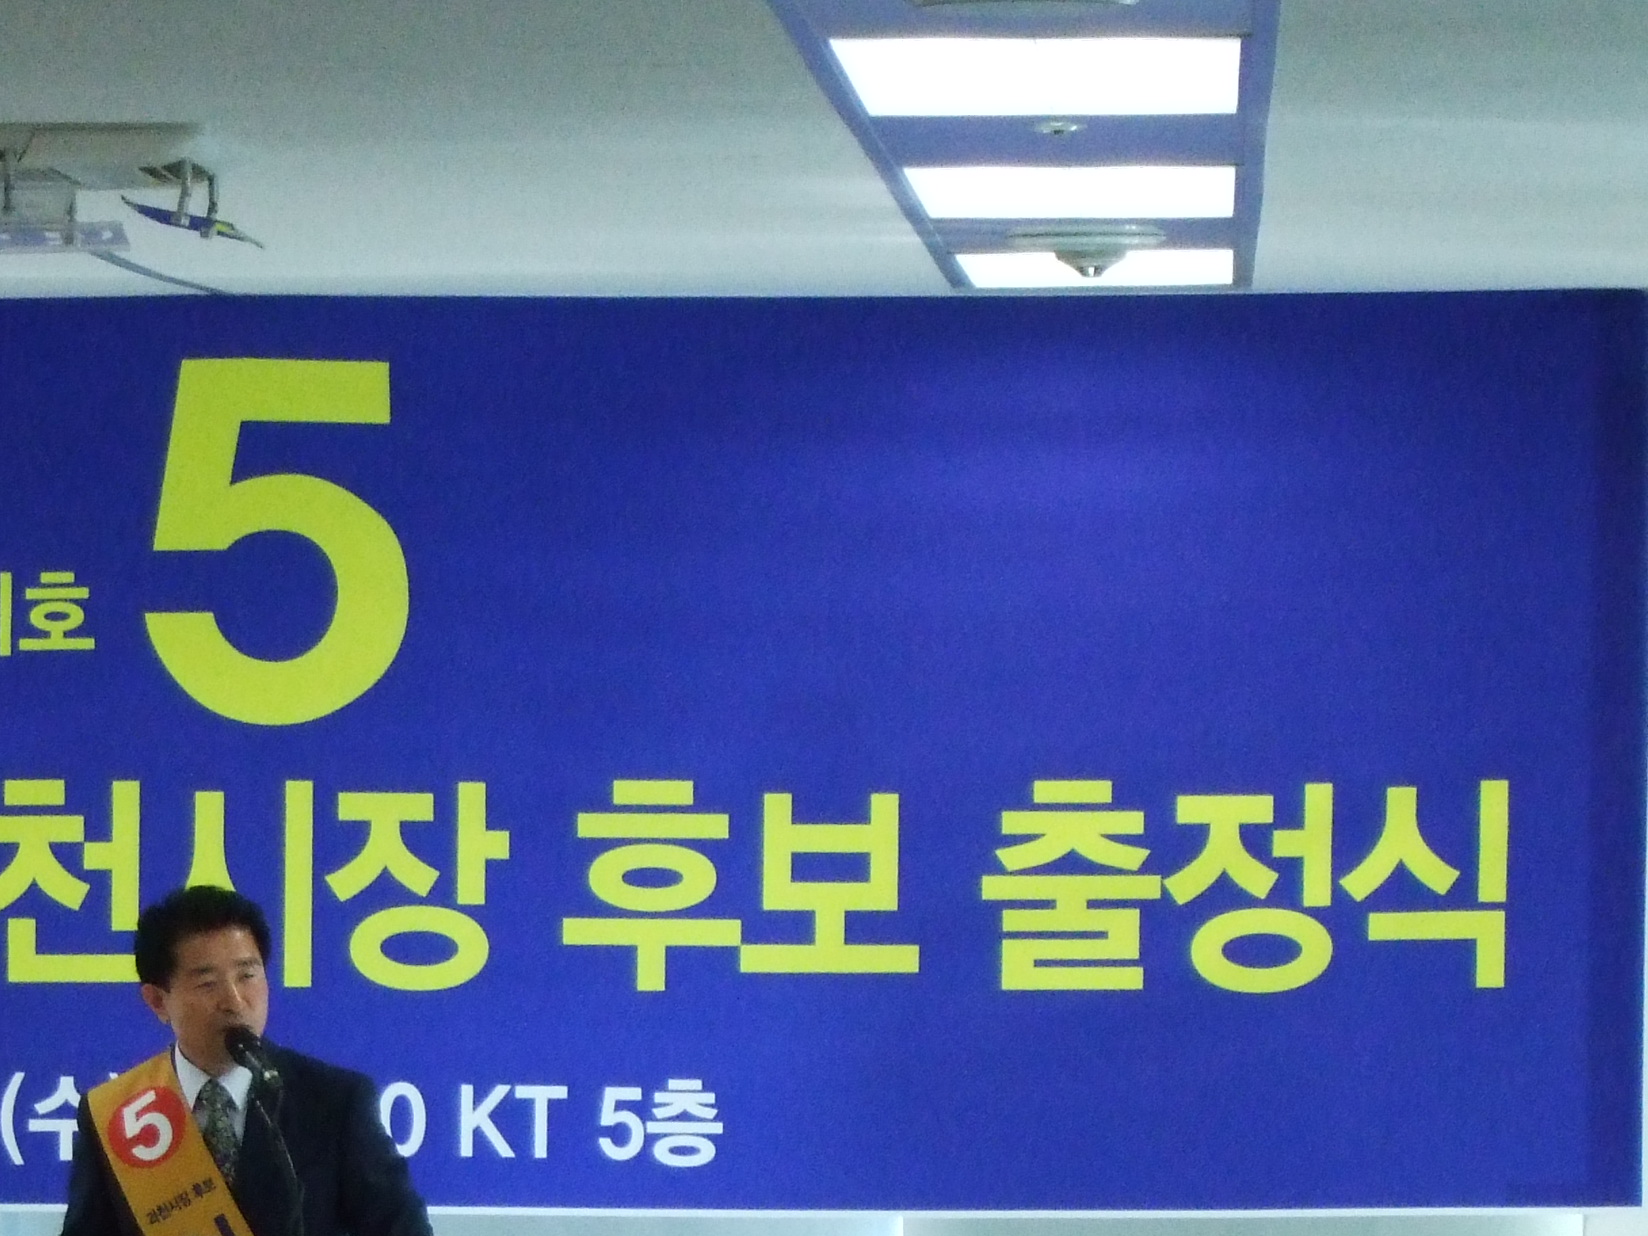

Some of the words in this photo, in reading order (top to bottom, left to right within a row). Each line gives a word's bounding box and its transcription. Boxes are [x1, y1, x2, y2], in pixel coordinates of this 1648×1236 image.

[144, 357, 410, 726] 5
[561, 779, 920, 992] 후보
[980, 779, 1510, 994] 출정식
[122, 1089, 174, 1162] 5
[458, 1083, 569, 1159] KT
[597, 1078, 724, 1168] 5층
